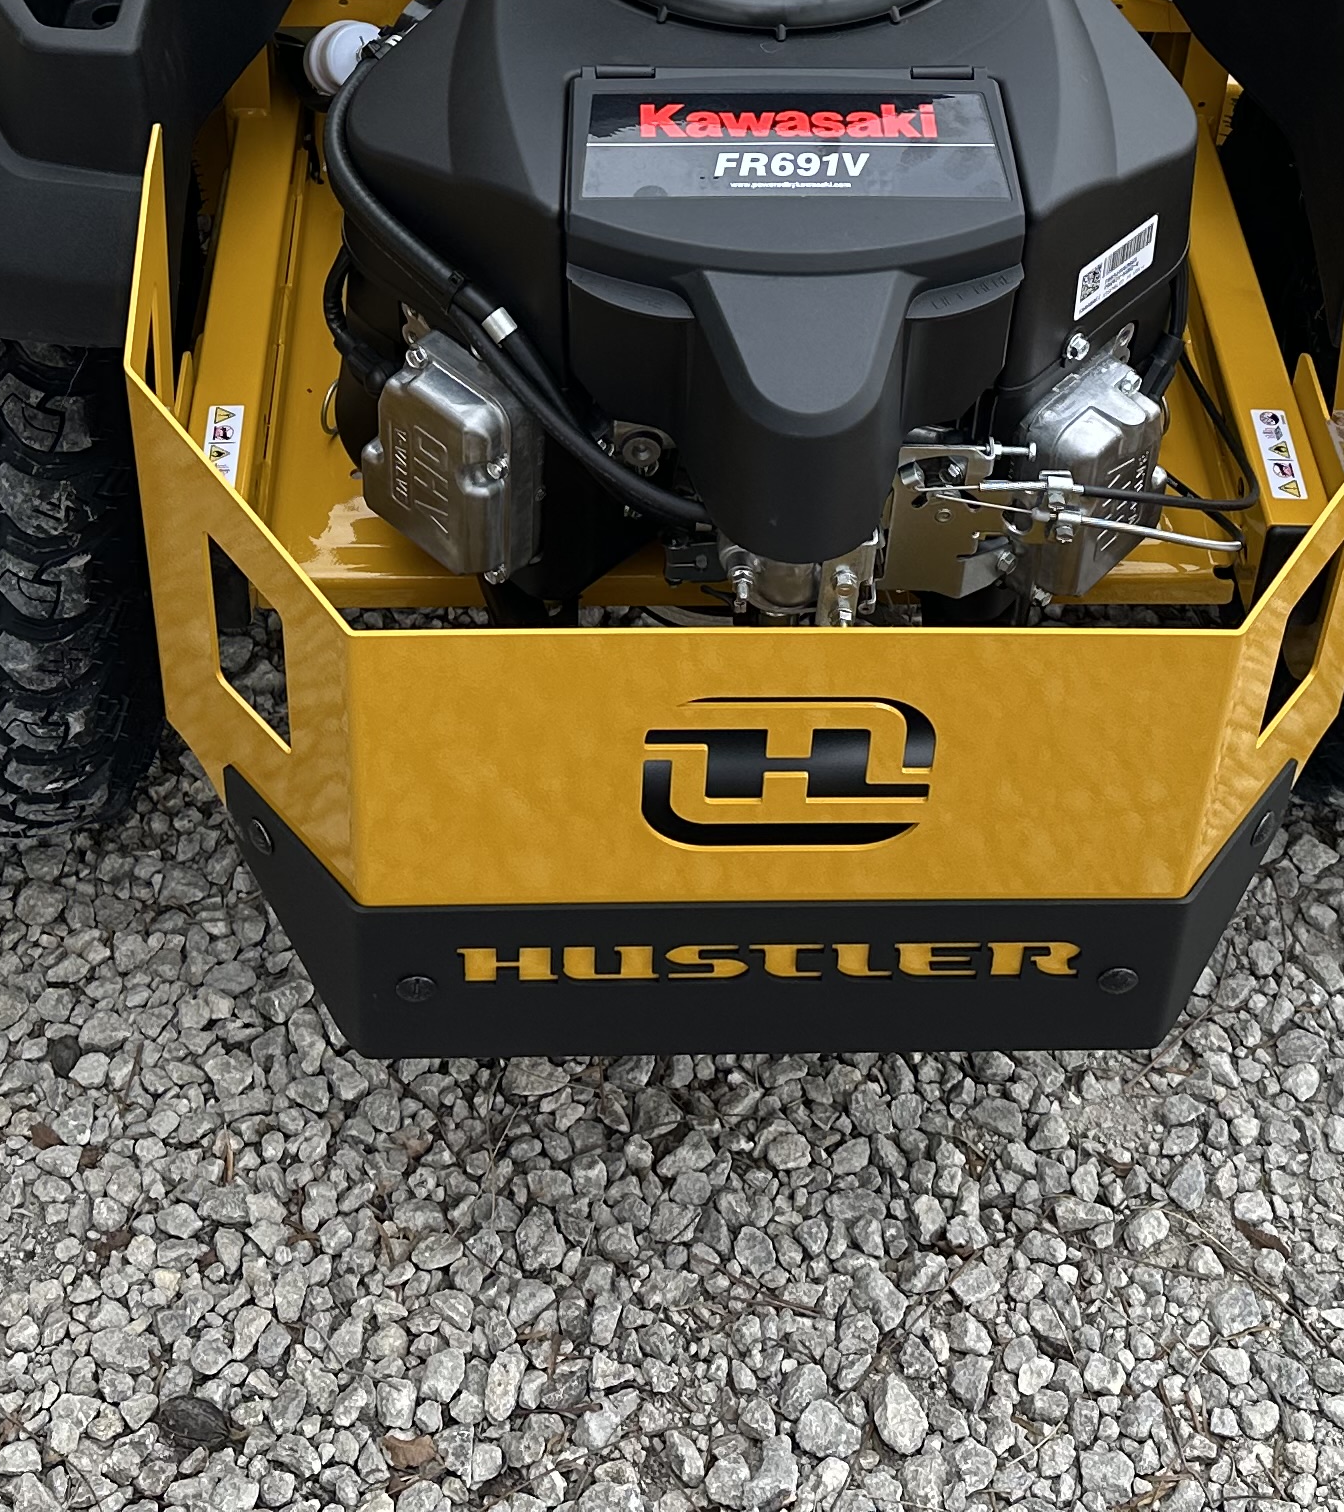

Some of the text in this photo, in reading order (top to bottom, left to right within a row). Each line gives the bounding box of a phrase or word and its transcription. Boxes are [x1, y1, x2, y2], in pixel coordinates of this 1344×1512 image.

[639, 103, 938, 140] Kawasaki
[714, 152, 871, 177] FR691V
[457, 942, 1081, 980] HUSTLER
